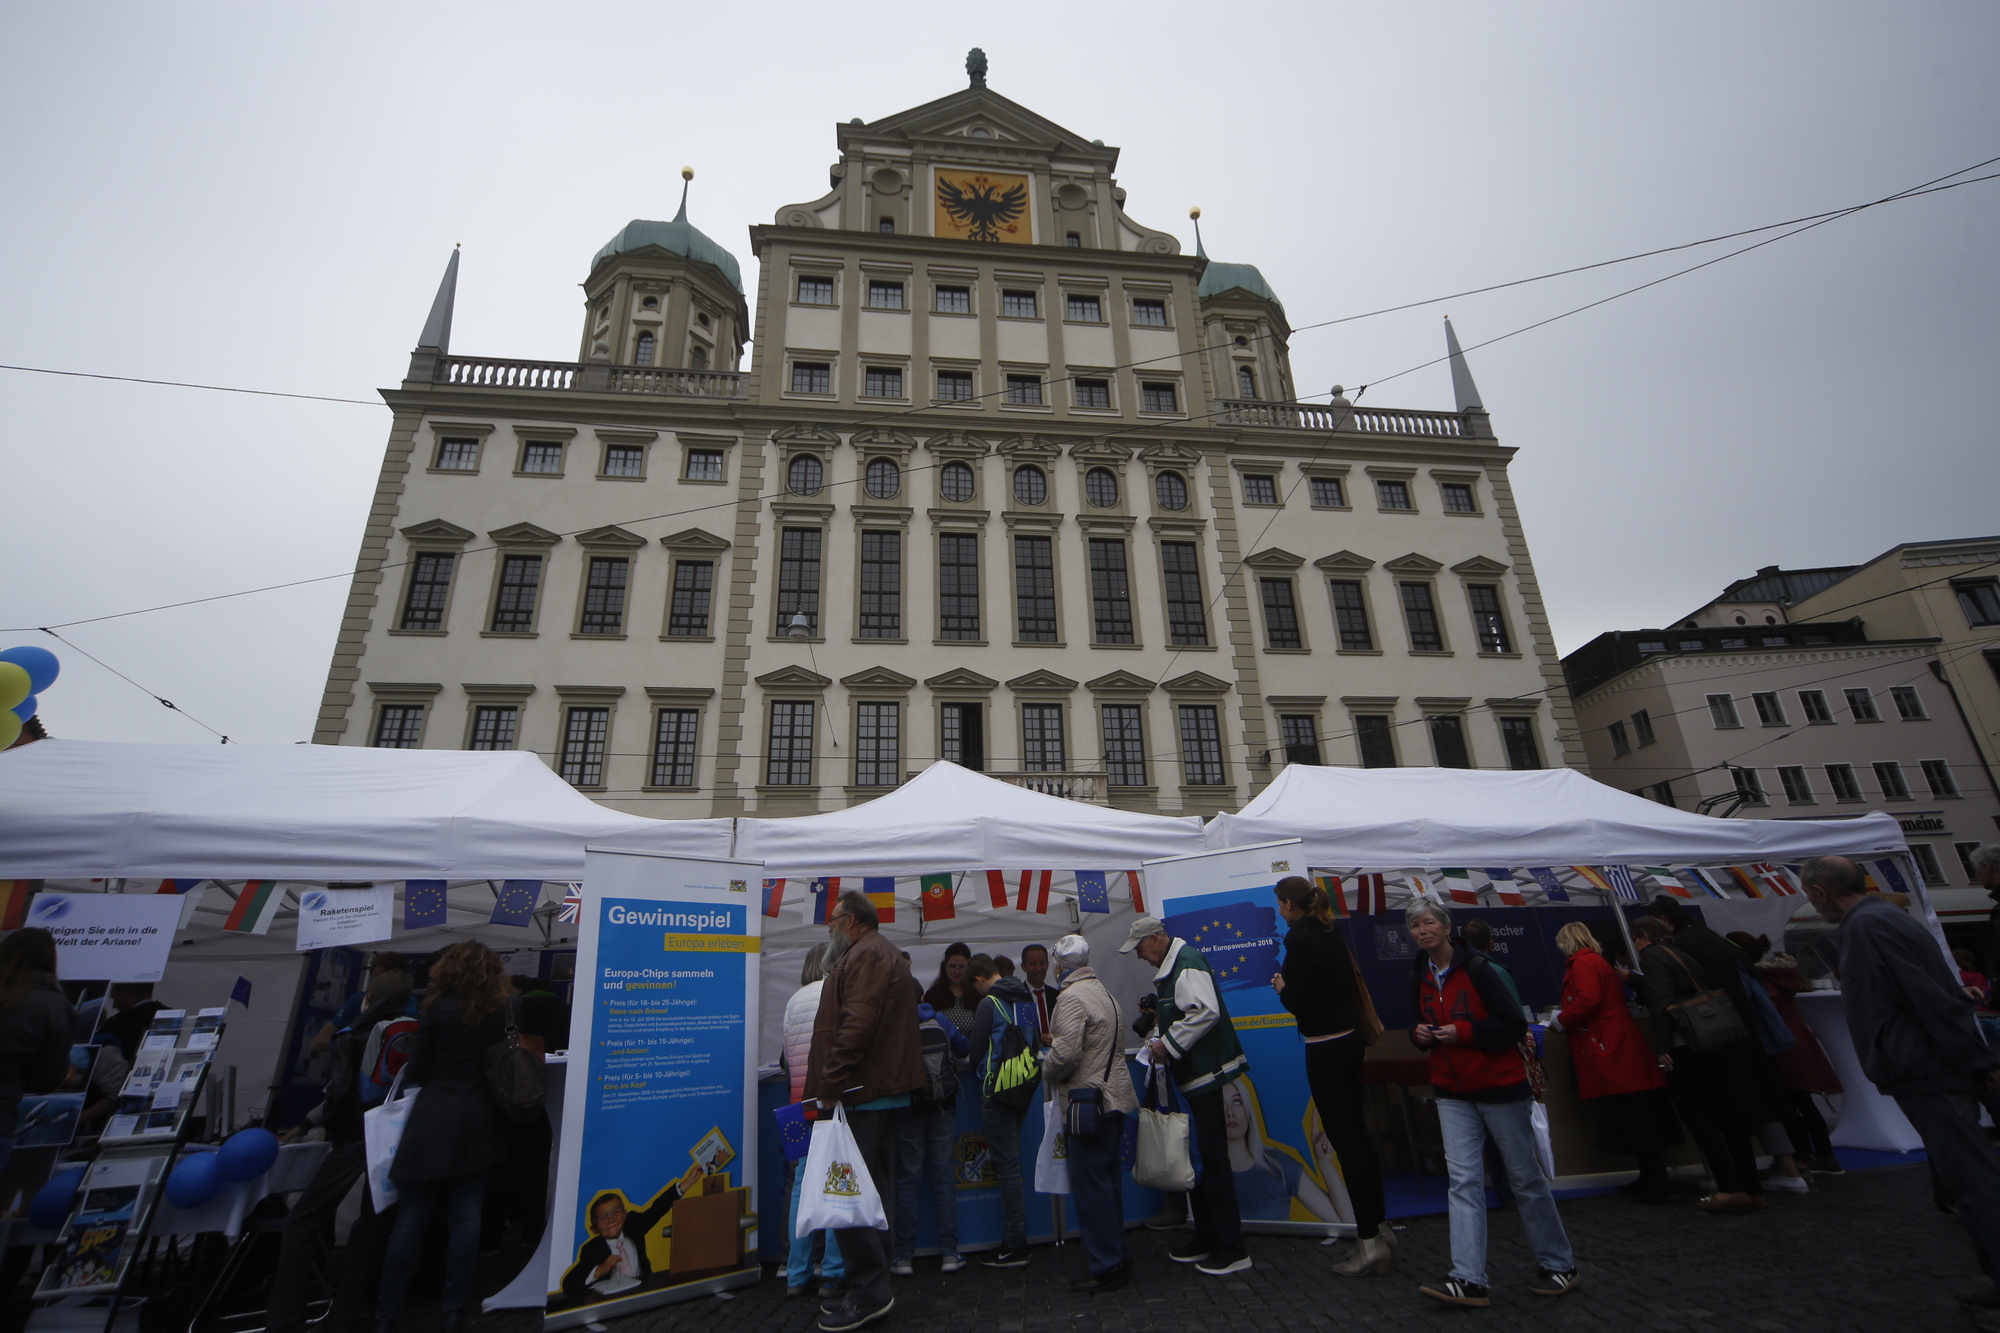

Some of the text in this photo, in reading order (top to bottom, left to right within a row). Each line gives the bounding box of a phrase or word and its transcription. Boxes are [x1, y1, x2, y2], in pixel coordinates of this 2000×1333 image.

[320, 904, 374, 916] Raketenspiel
[608, 906, 730, 931] Gewinnspiel
[669, 937, 744, 950] Europa erleben
[1213, 942, 1256, 952] Europawoche
[604, 968, 714, 979] Europa-Chips sammeln
[604, 980, 677, 991] und gewinnen!
[655, 1070, 691, 1078] 10-Jährige):
[994, 1046, 1039, 1093] NIKE
